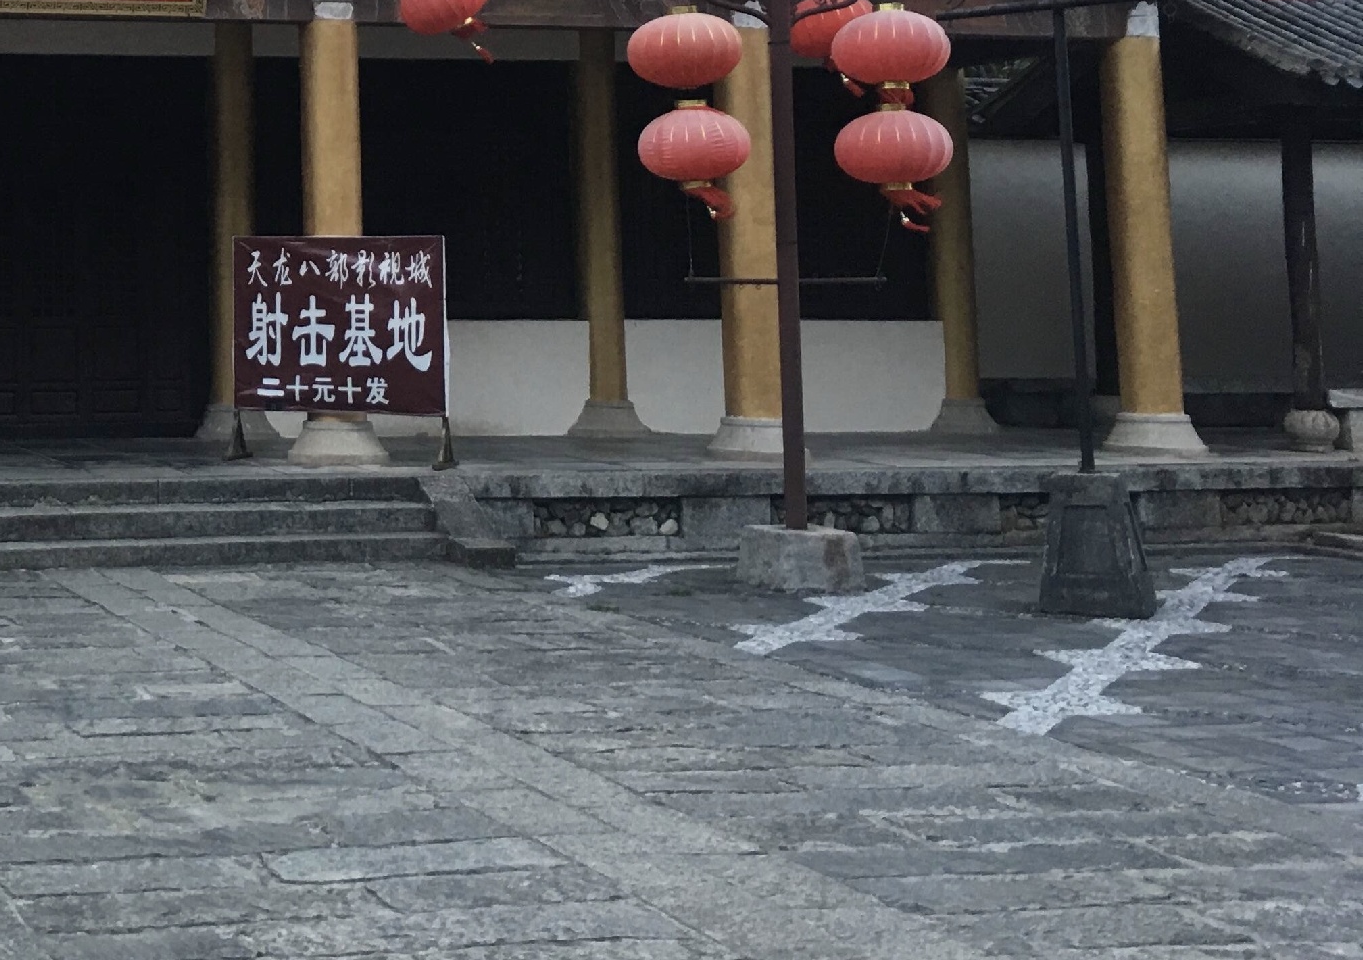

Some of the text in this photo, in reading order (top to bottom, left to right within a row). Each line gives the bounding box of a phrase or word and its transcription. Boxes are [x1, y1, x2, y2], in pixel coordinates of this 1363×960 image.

[245, 292, 433, 372] 射击基地
[256, 375, 390, 405] 二十元十发
